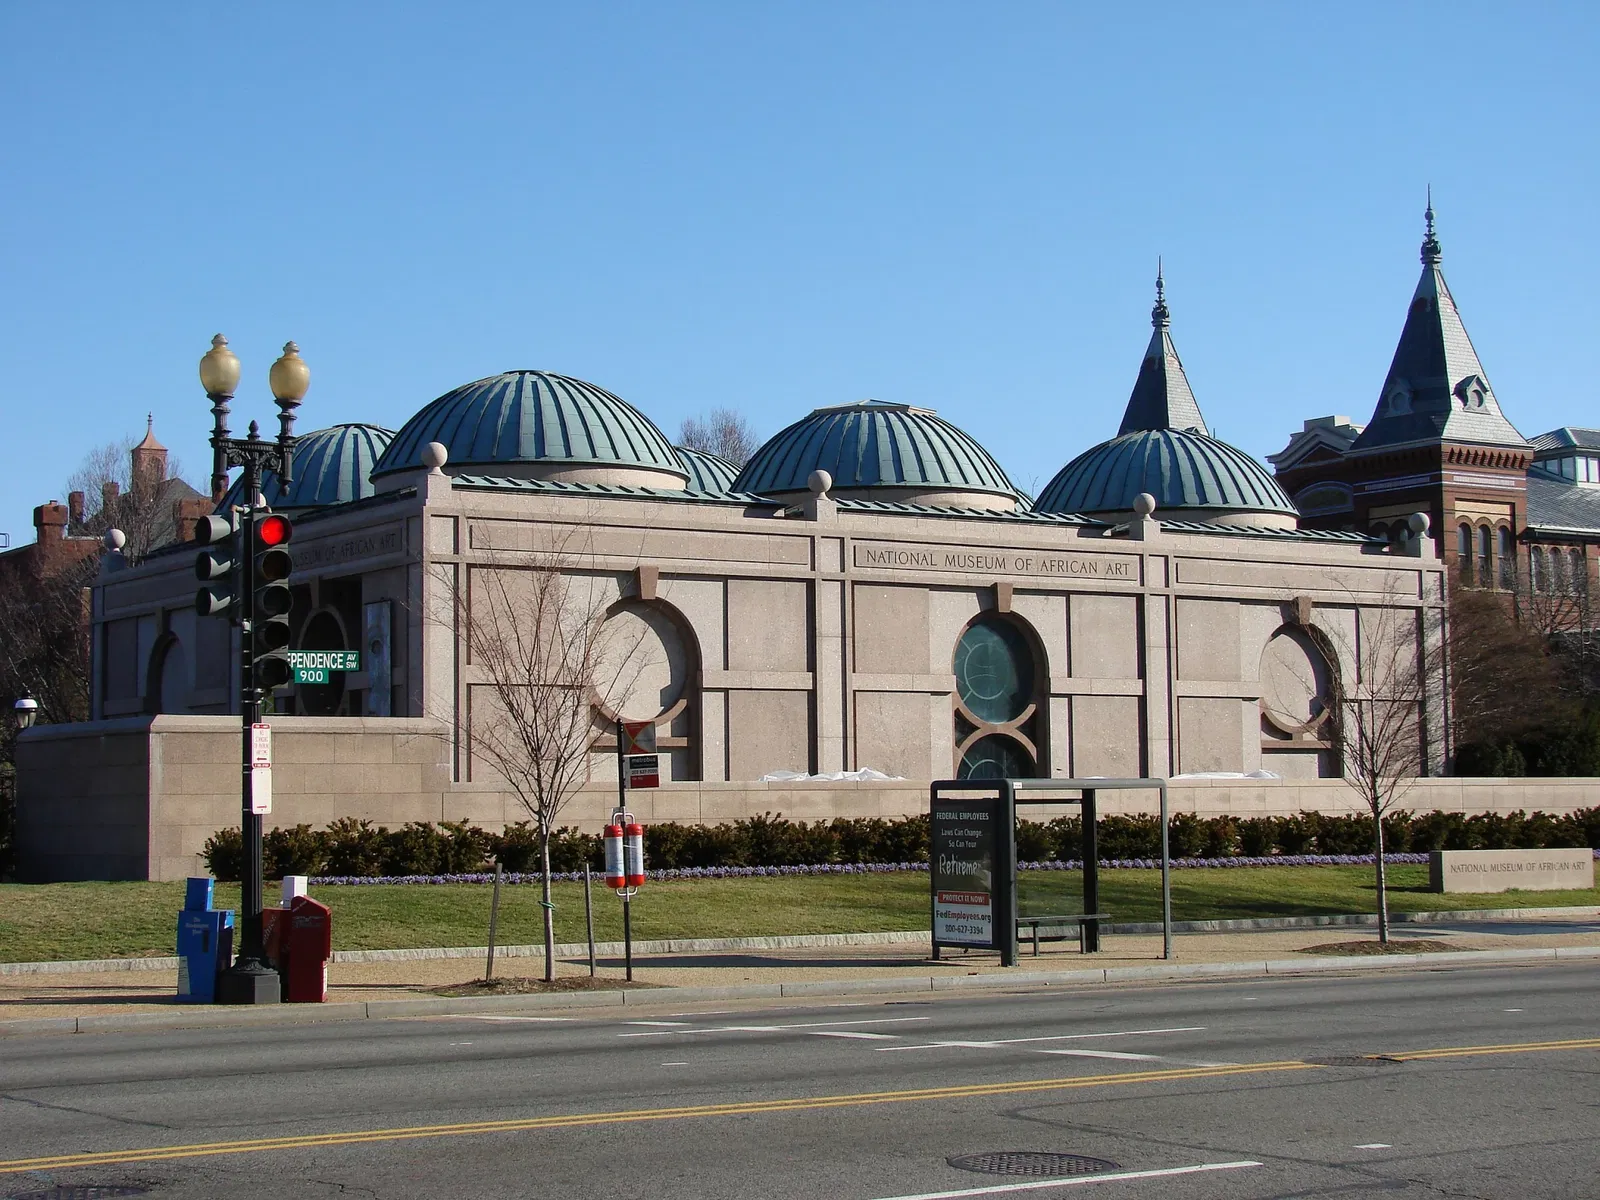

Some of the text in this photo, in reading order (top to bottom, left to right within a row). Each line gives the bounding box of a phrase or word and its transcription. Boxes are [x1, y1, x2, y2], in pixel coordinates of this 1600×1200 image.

[340, 536, 376, 558] AFRICAN
[380, 533, 397, 549] ART
[866, 549, 1130, 576] NATIONAL MUSEUM OF AFRICAN ART
[346, 653, 356, 661] AV
[346, 661, 357, 669] SW
[300, 670, 324, 682] 900
[936, 812, 989, 821] FEDERAL EMPLOYEES
[941, 828, 953, 836] Laws
[954, 828, 964, 836] Can
[948, 840, 977, 848] So Can Your
[1450, 861, 1586, 873] NATIONAL MUSEUM OF AFRICAN ART
[942, 894, 964, 902] PROTECT
[970, 895, 985, 903] NOW!
[936, 909, 992, 924] FedEmployees.org
[944, 924, 984, 935] 800-627-3394
